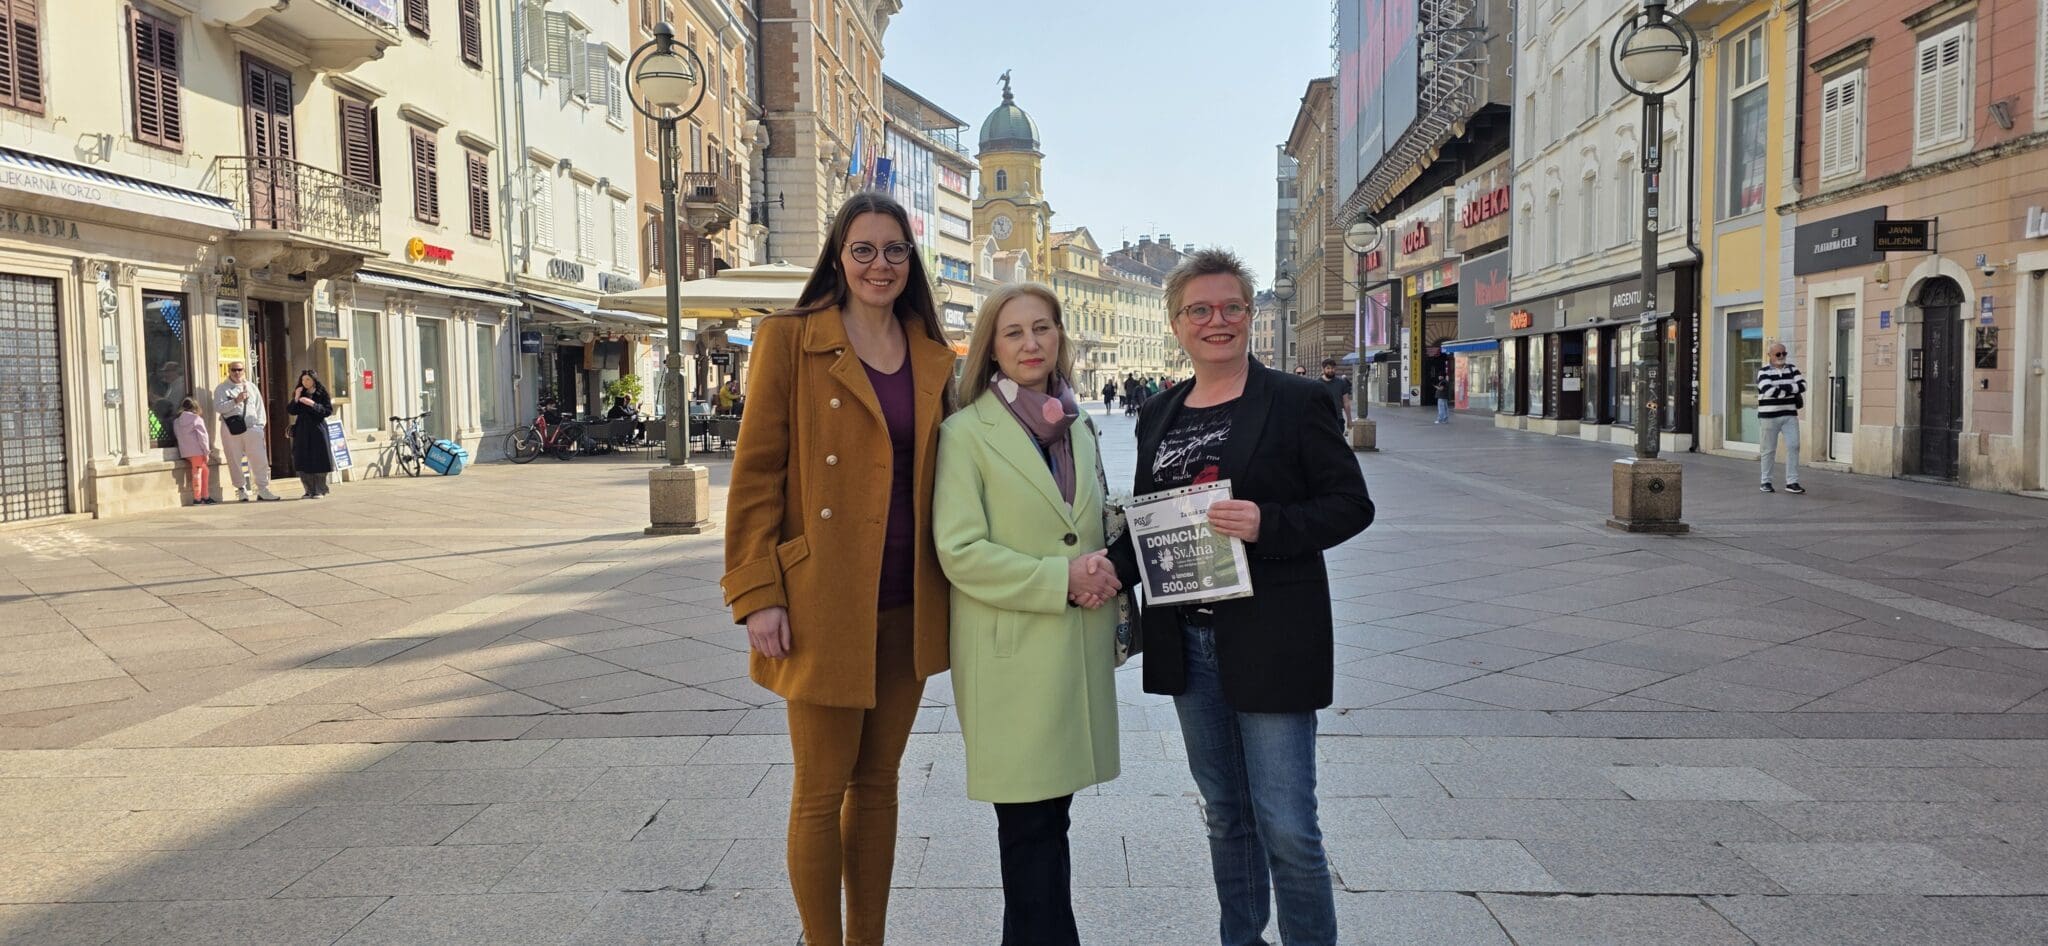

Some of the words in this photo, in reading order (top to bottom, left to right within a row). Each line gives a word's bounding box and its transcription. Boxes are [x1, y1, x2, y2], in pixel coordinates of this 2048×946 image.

[61, 181, 102, 201] KORZO
[1462, 185, 1510, 229] RIJEKA
[1888, 226, 1913, 234] JAVNI
[1814, 240, 1840, 254] ZLATARNA
[1841, 236, 1857, 248] CELJE
[1878, 237, 1922, 246] BILJEŽNIK
[549, 258, 584, 283] CORSO
[1147, 527, 1212, 549] DONACIJA
[1173, 544, 1214, 560] Sv.Ana
[1162, 580, 1199, 593] 500,00
[1202, 576, 1214, 587] €
